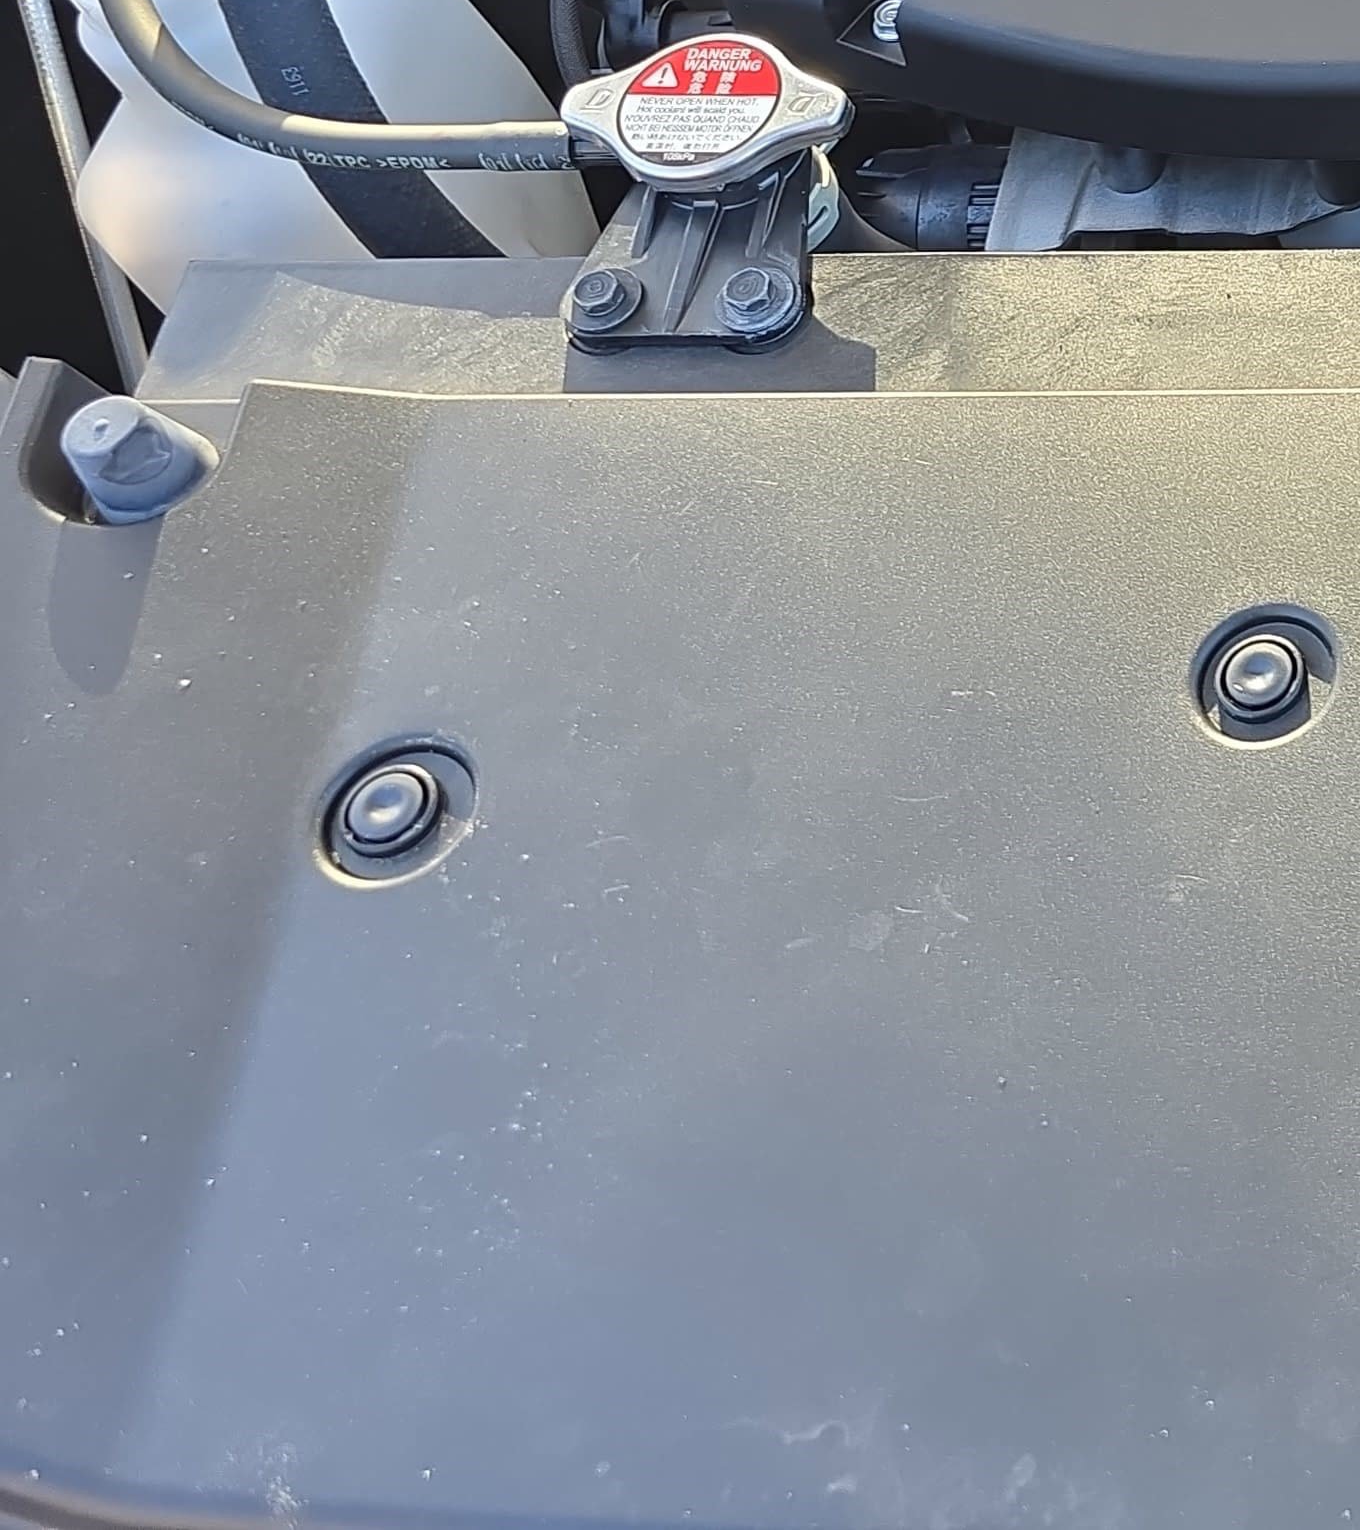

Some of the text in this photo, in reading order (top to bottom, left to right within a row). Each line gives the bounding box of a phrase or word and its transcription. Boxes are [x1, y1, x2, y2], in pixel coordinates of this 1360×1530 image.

[686, 48, 752, 60] DANGER
[683, 59, 762, 72] WARNUNG
[640, 98, 673, 106] NEVER
[675, 98, 704, 106] OPEN
[705, 98, 735, 106] WHEN
[636, 106, 653, 114] Hot
[654, 106, 686, 114] coolant
[687, 106, 702, 114] will
[703, 106, 727, 114] scald
[674, 115, 692, 123] PAS
[693, 115, 726, 123] QUAND
[727, 115, 760, 123] CHAUD
[624, 124, 648, 132] NICHT
[648, 124, 661, 132] BEI
[695, 124, 723, 132] MOTOR
